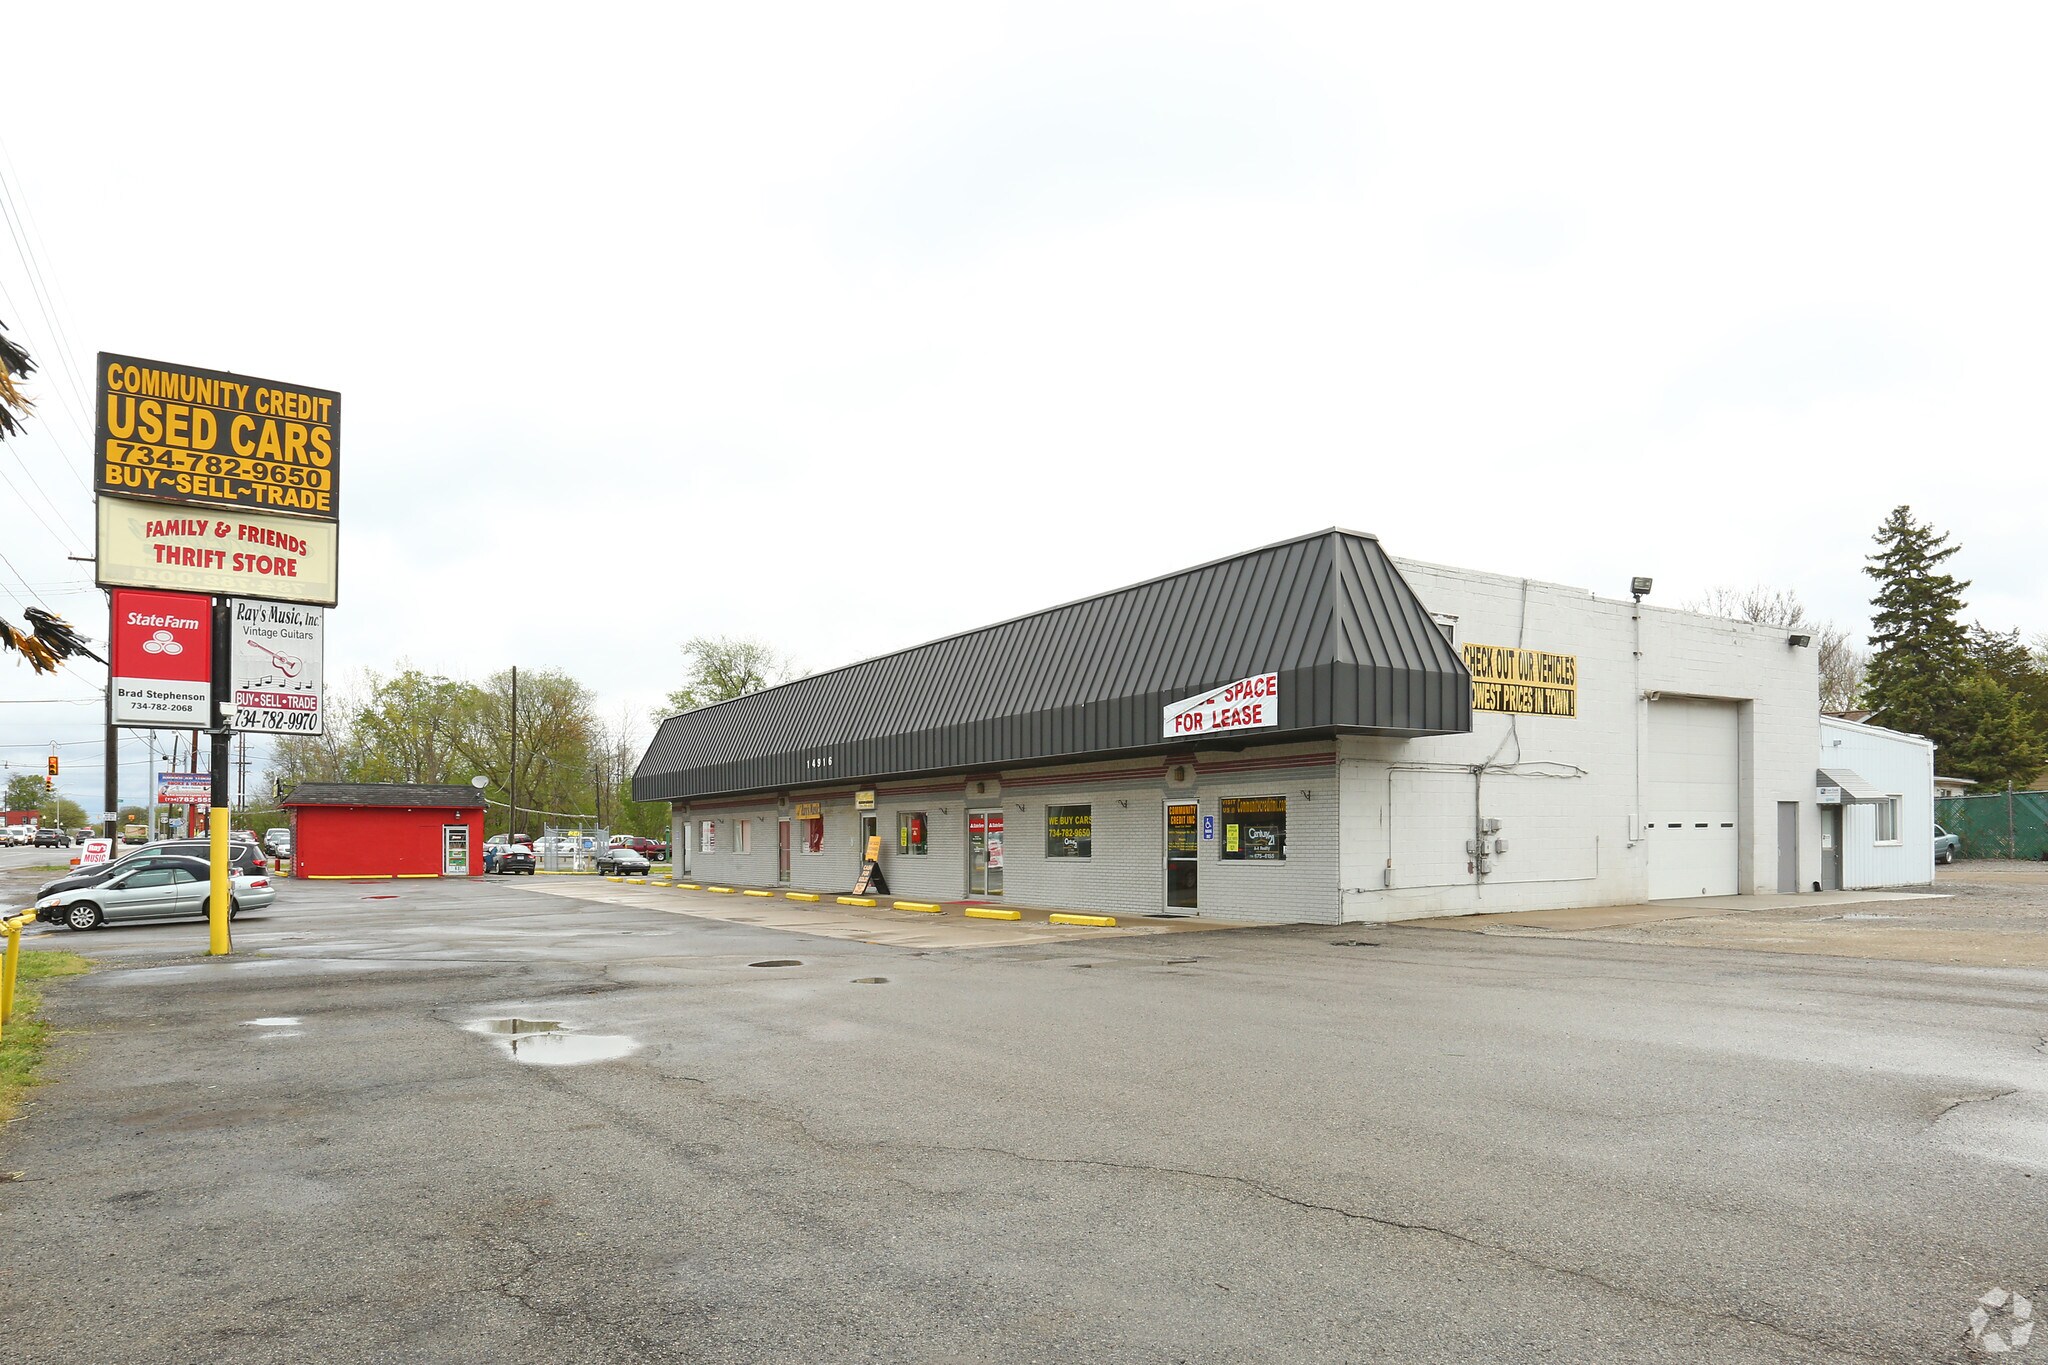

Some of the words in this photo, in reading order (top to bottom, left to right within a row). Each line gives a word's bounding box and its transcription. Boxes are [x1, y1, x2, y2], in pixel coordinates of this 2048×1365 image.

[107, 362, 249, 409] COMMUNITY
[255, 387, 332, 423] CREDIT
[107, 394, 218, 450] USED
[230, 414, 332, 467] CARS
[116, 442, 322, 488] 734-782-9650
[146, 520, 208, 538] FAMILY
[214, 522, 231, 538] &
[238, 524, 307, 556] FRIENDS
[154, 543, 226, 570] THRIFT
[232, 552, 297, 577] STORE
[237, 602, 267, 626] Ray's
[243, 625, 278, 639] Vintage
[280, 628, 314, 640] Guitars
[1463, 645, 1493, 678] CHECK
[1496, 649, 1515, 680] OUT
[1518, 651, 1534, 682] OUR
[1537, 653, 1576, 686] VEHICLES
[118, 688, 143, 698] Brad
[146, 690, 206, 702] Stephenson
[1224, 676, 1276, 702] SPACE
[1472, 682, 1502, 709] OWEST
[1503, 685, 1533, 712] PRICES
[1535, 688, 1543, 713] IN
[130, 702, 193, 713] 734-782-2068
[234, 709, 318, 731] 734-782-9970
[1175, 711, 1203, 734] FOR
[1212, 704, 1262, 728] LEASE
[806, 757, 832, 769] 14916
[1049, 816, 1059, 825] WE
[1060, 816, 1074, 825] BUY
[1075, 815, 1094, 825] CARS
[1169, 806, 1197, 815] COMMUNITY
[1170, 815, 1186, 825] CREDIT
[1187, 815, 1196, 825] INC
[1049, 828, 1091, 837] 734-782-9650
[1248, 827, 1271, 840] Century
[1268, 834, 1276, 846] 21
[84, 854, 106, 863] MUSIC
